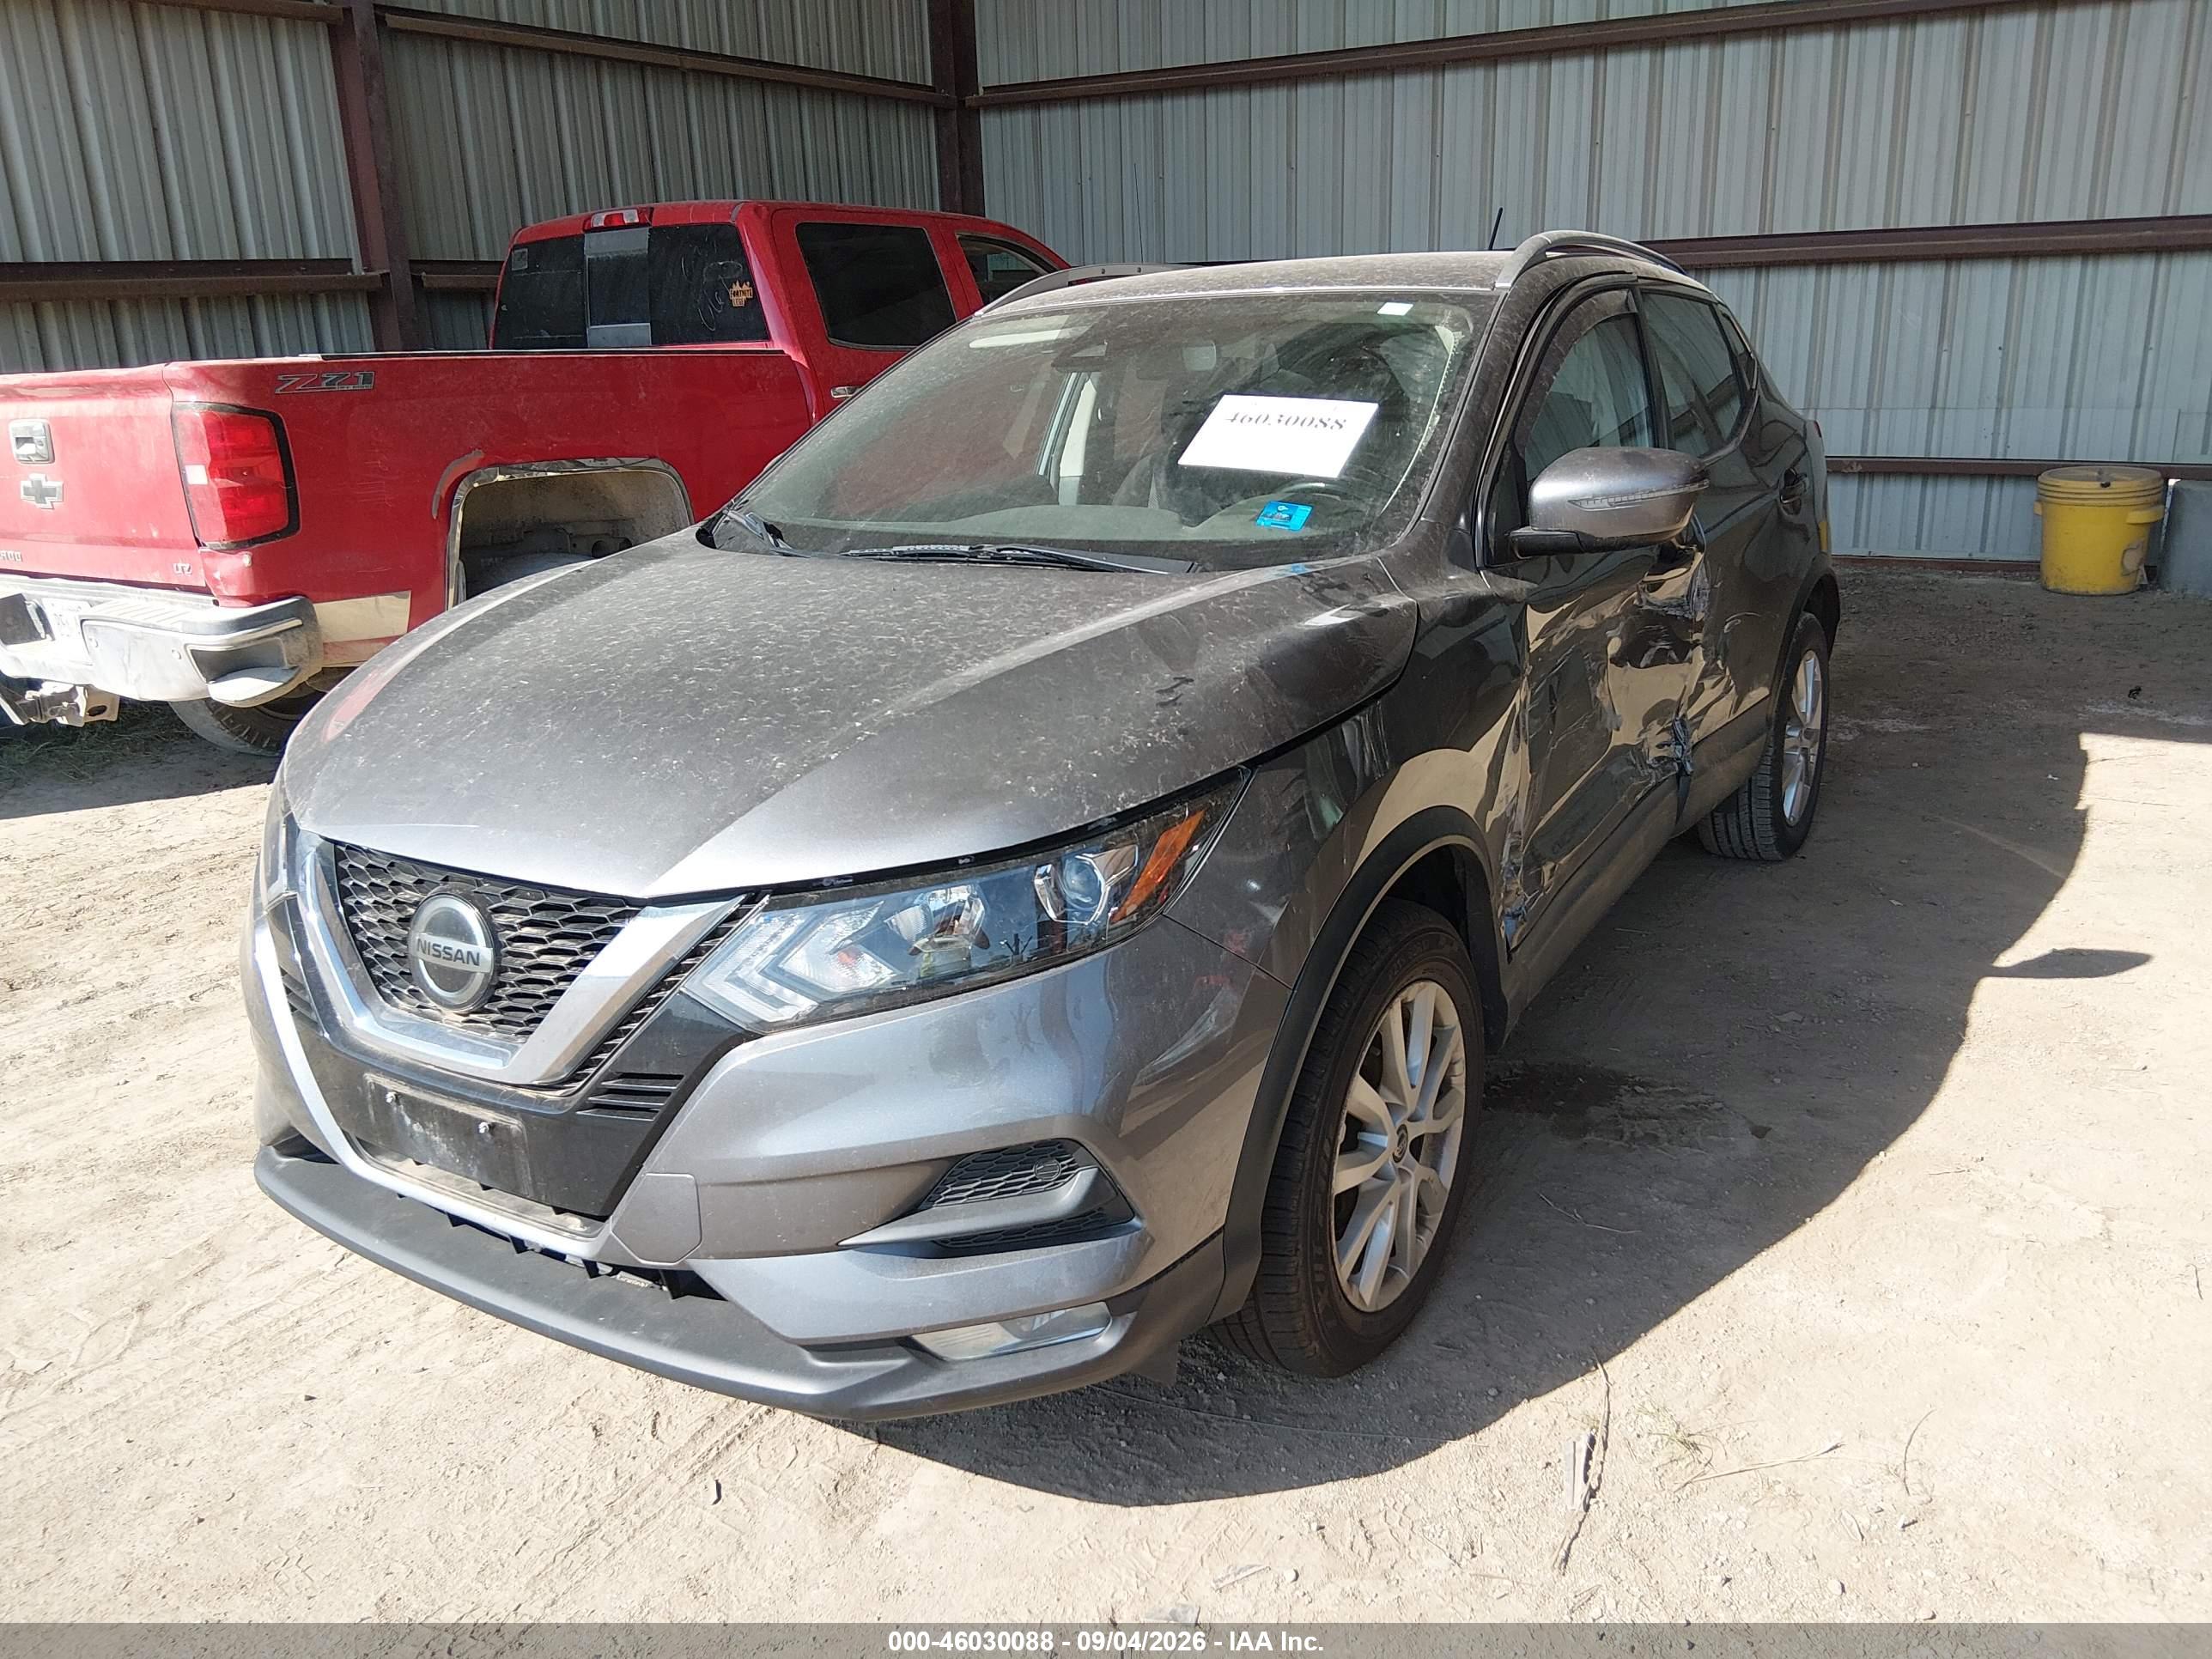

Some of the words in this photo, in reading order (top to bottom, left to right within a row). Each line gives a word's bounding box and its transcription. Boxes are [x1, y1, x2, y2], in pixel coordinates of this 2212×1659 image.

[275, 371, 375, 394] Z71
[1224, 411, 1346, 430] 46030088
[416, 938, 481, 967] NISSAN
